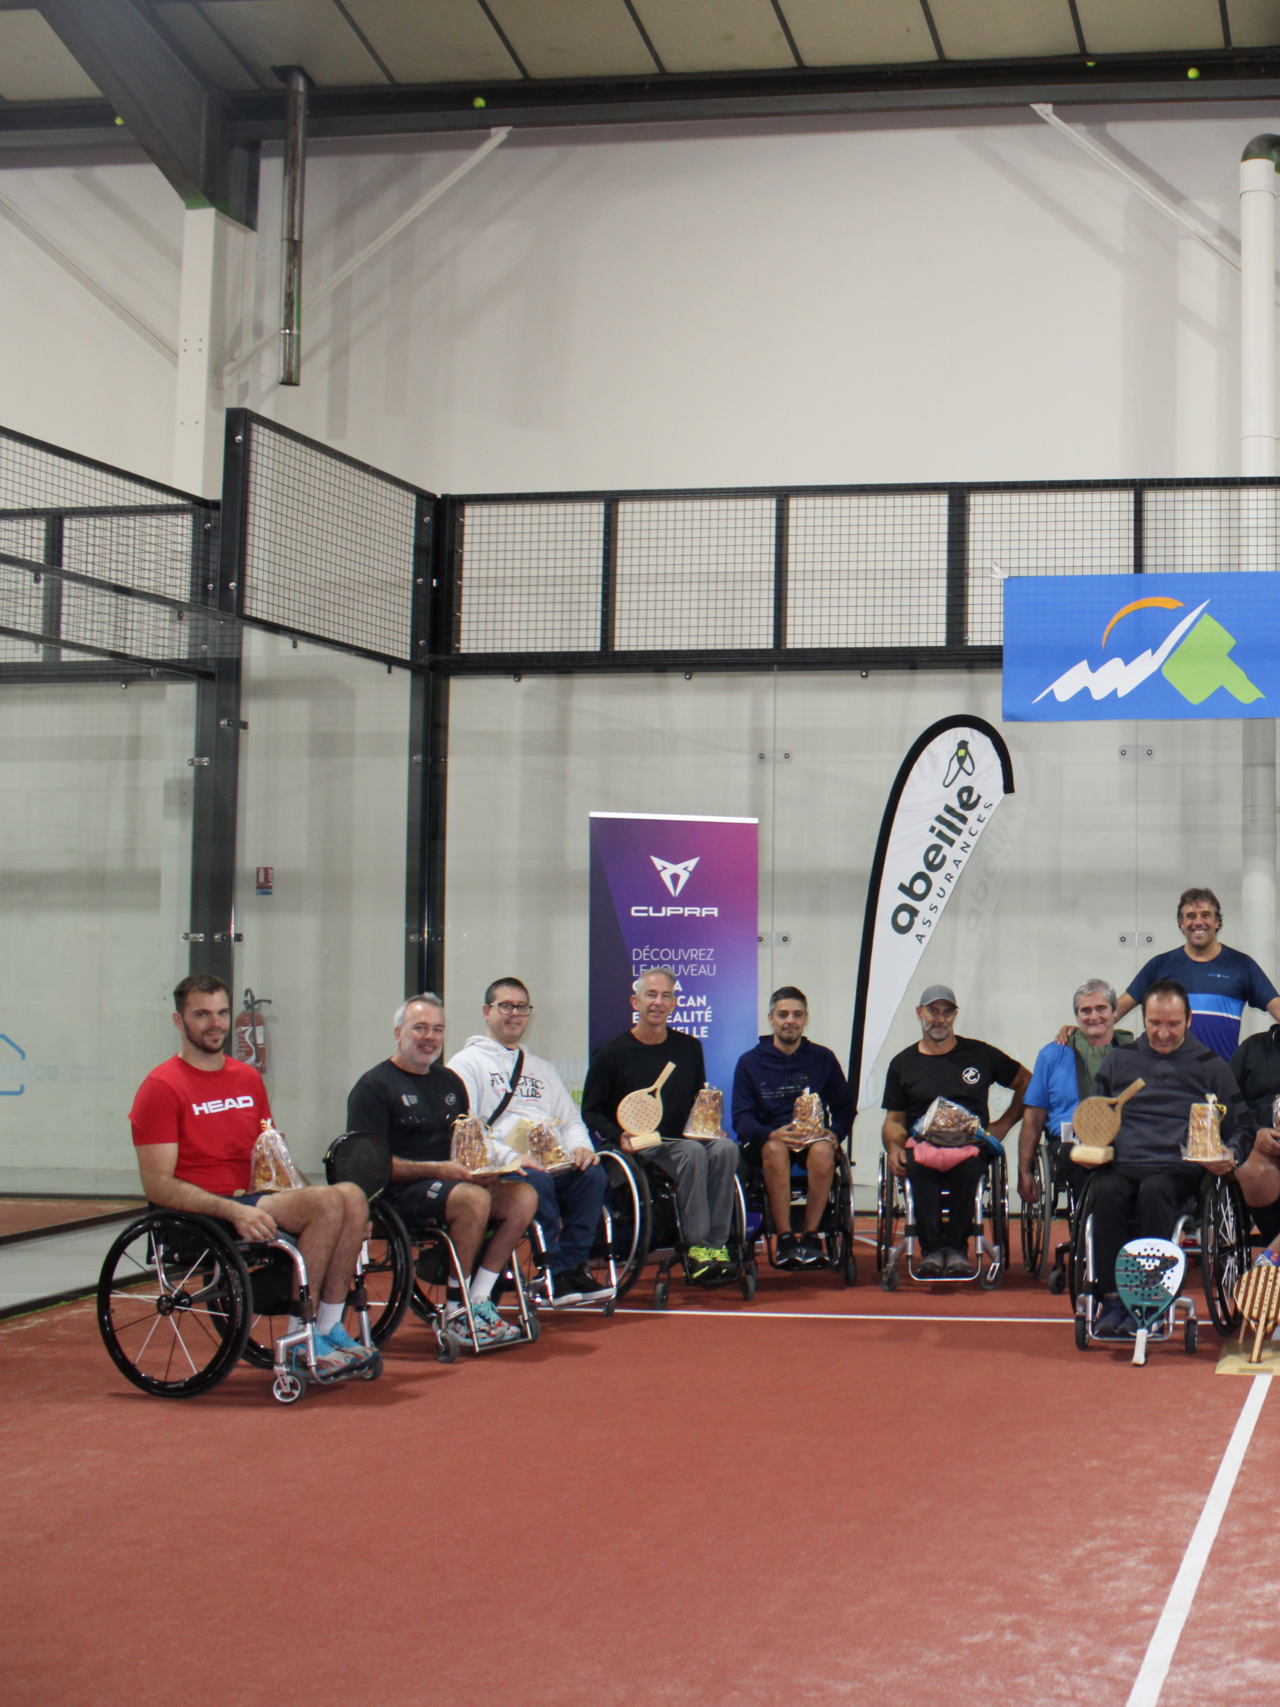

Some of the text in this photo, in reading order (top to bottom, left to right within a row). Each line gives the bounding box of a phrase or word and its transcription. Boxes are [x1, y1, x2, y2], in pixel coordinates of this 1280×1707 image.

[890, 785, 982, 935] abeille
[914, 801, 994, 944] ASSURANCES
[630, 906, 719, 917] CUPRA
[632, 945, 715, 961] DÉCOUVREZ
[192, 1095, 255, 1116] HEAD
